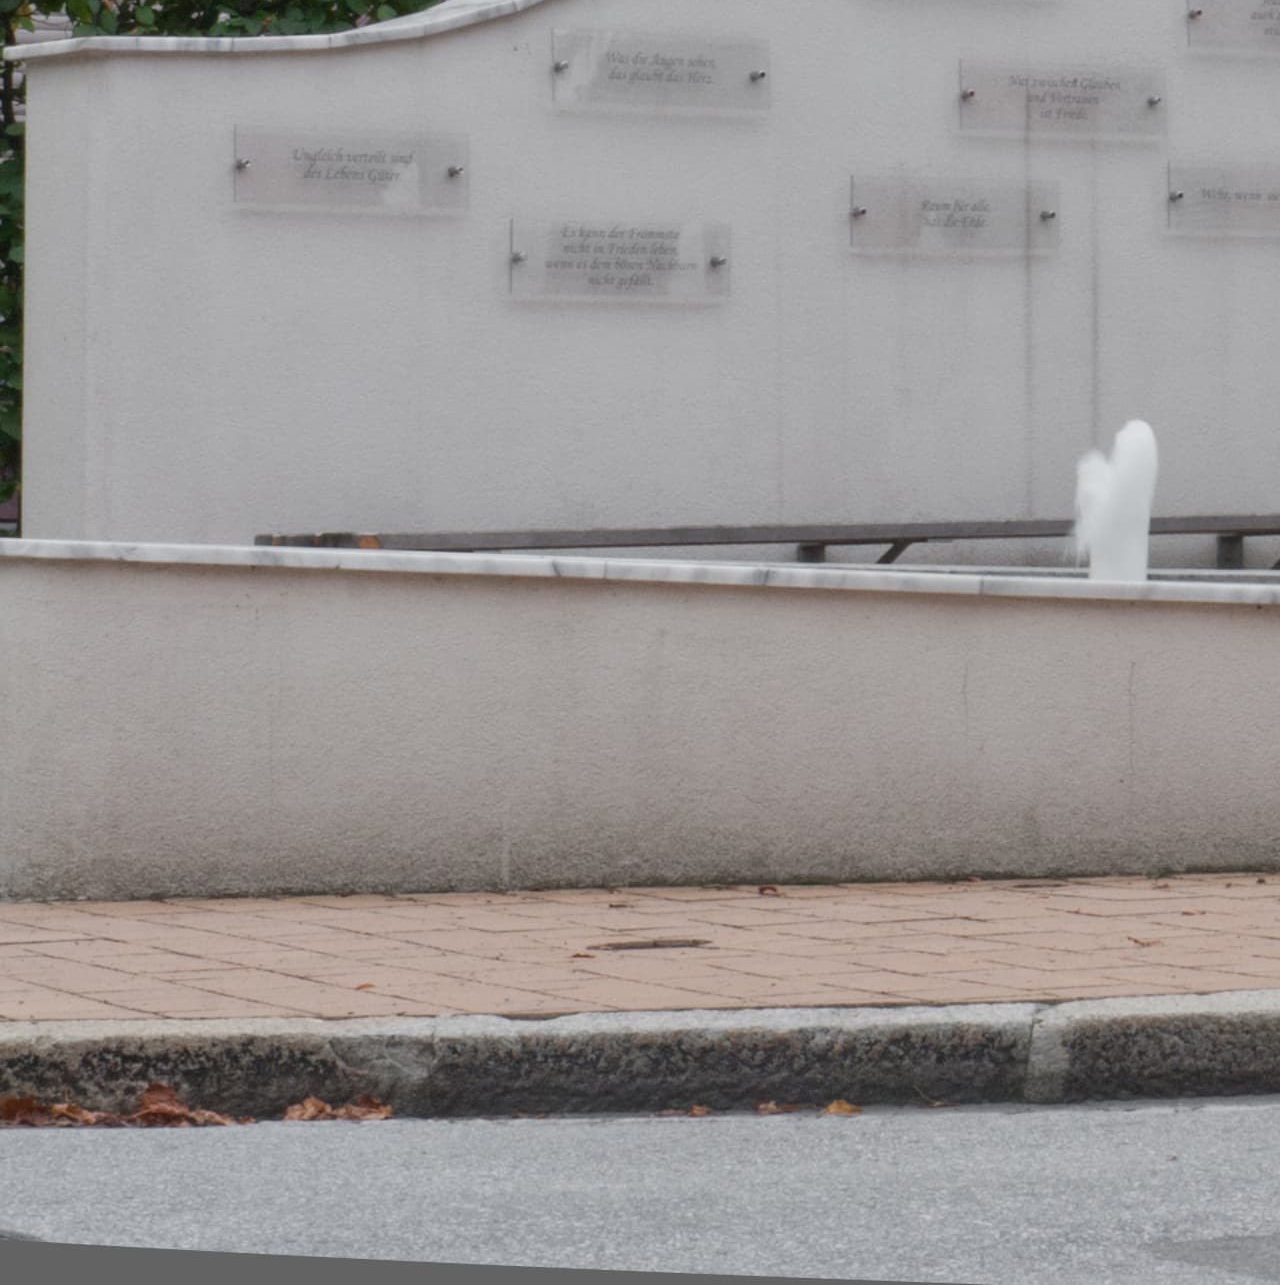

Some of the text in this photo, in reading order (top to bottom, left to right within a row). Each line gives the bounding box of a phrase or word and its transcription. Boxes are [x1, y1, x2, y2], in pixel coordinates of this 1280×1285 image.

[607, 51, 629, 66] Was
[632, 51, 647, 65] die
[651, 53, 685, 69] Augen
[608, 68, 626, 80] das
[628, 70, 663, 83] glaubt
[665, 70, 683, 82] das
[292, 147, 343, 164] Ungleich
[303, 166, 321, 179] des
[326, 168, 365, 180] Lebens
[607, 227, 625, 239] der
[608, 244, 646, 255] Frieden
[590, 258, 610, 270] dem
[588, 274, 615, 285] nicht
